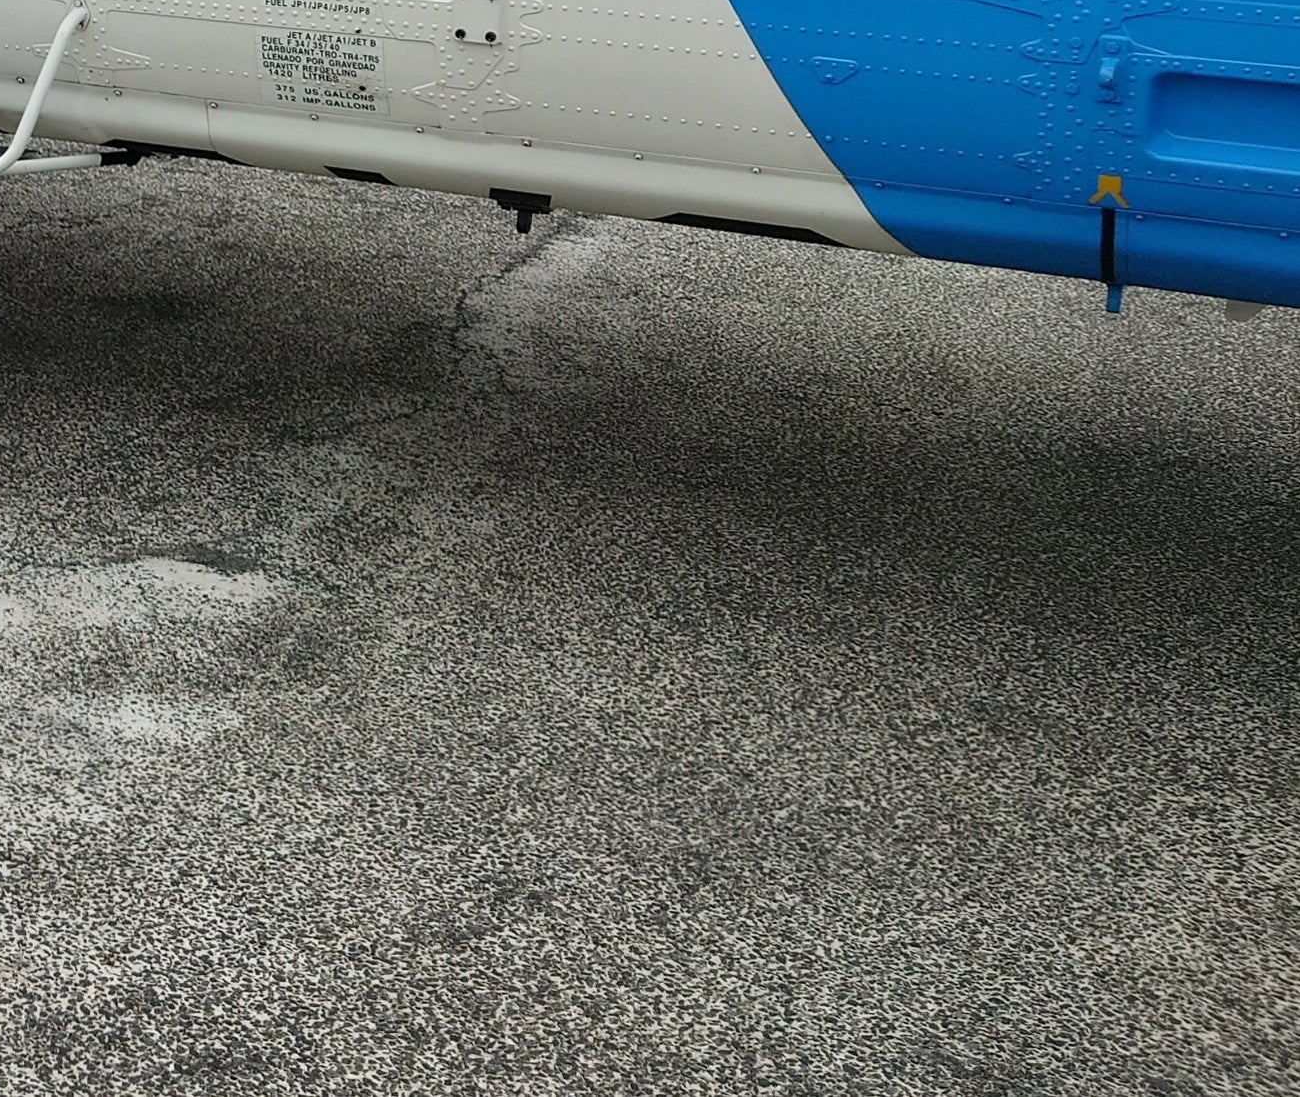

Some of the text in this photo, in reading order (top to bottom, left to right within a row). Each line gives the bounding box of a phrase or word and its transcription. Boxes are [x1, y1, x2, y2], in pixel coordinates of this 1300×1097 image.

[291, 2, 371, 15] JP1/JP4/JP5/JP8
[261, 36, 283, 45] FUEL
[287, 31, 302, 39] JET
[262, 53, 376, 71] LLENADO POR GRAVEDAD
[263, 61, 357, 78] GRAVITY REFUELLING
[268, 69, 339, 83] 1420 LITRES
[275, 84, 295, 93] 375
[277, 94, 297, 102] 312
